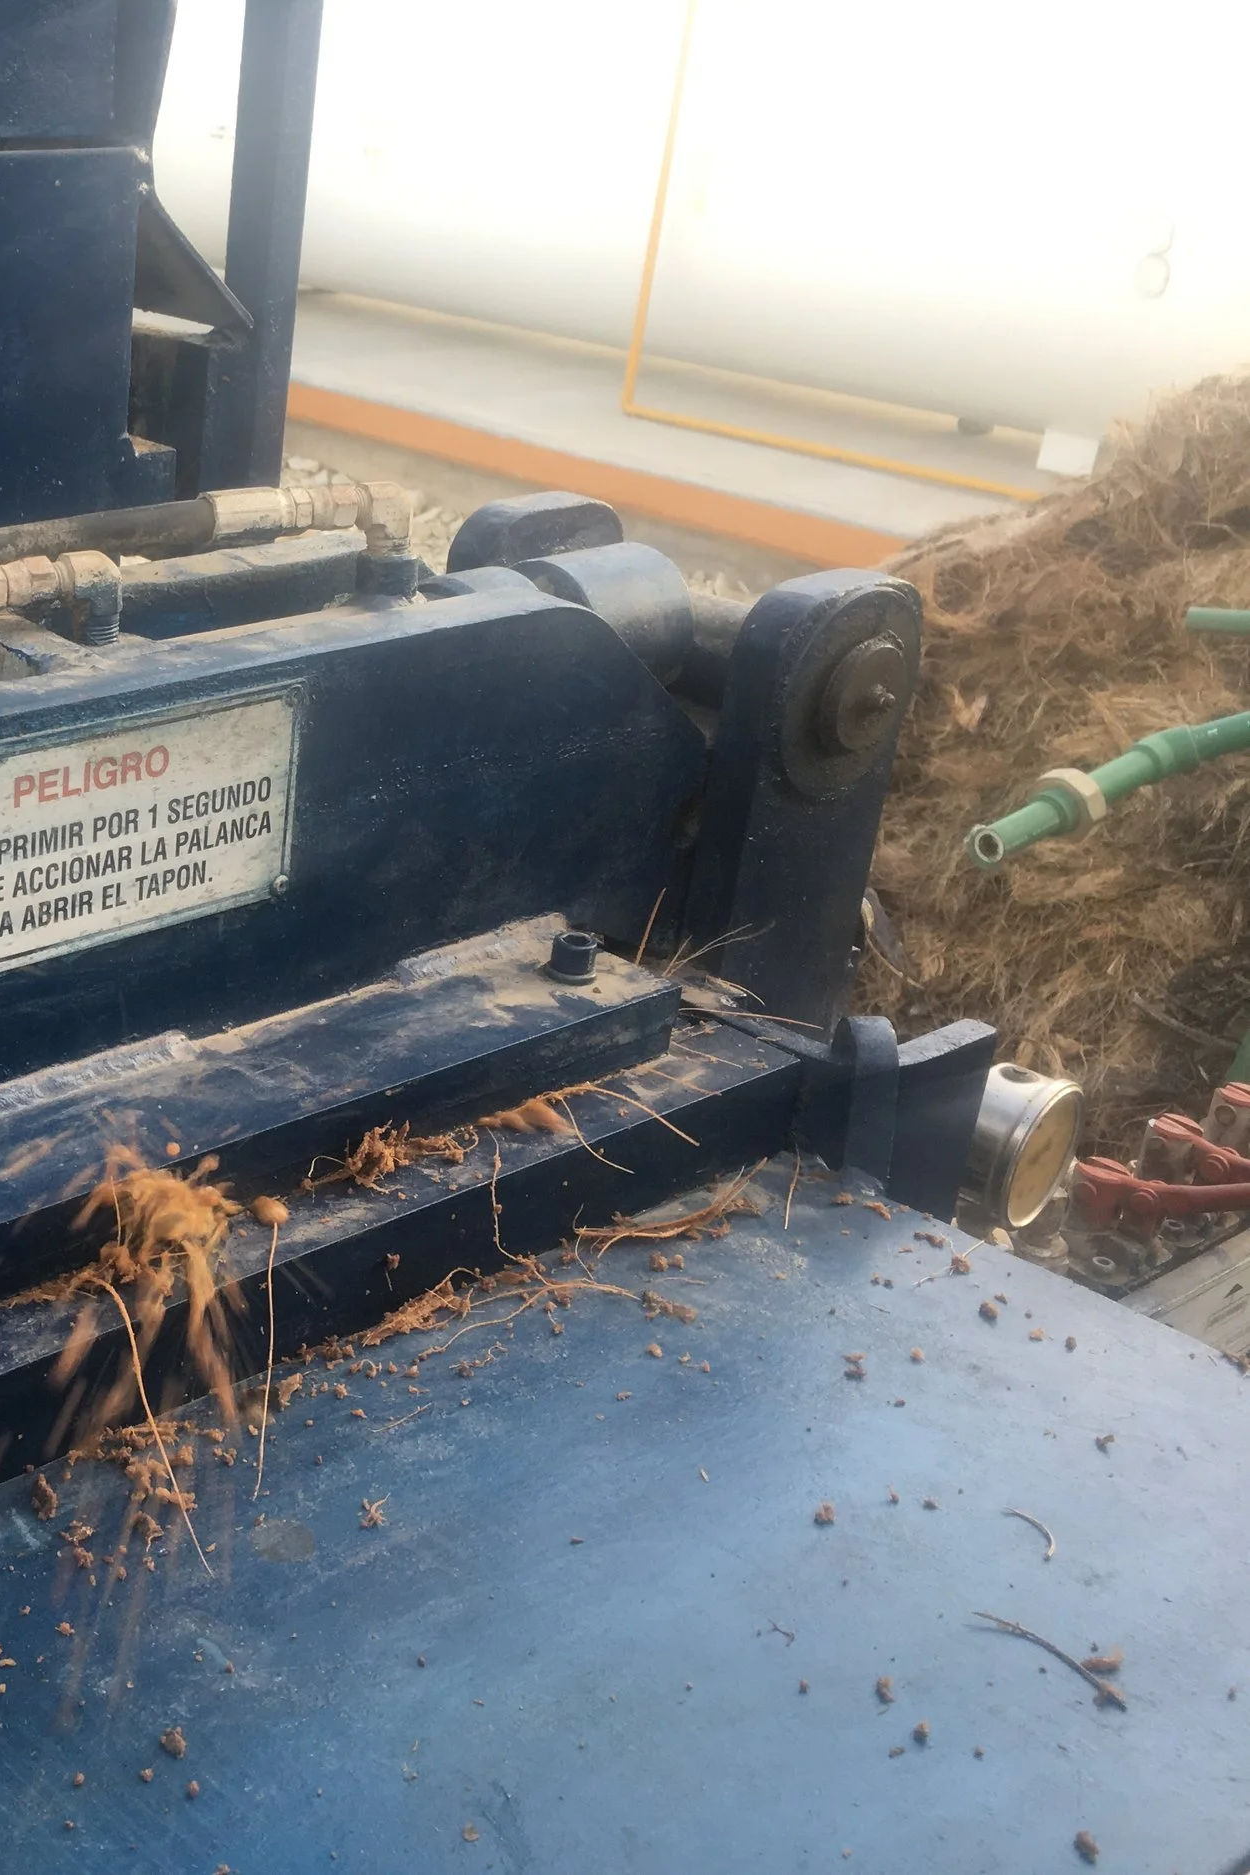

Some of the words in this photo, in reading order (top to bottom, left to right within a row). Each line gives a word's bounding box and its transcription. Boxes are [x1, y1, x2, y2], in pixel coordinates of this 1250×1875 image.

[14, 745, 170, 809] PELIGRO
[93, 808, 139, 843] POR
[148, 803, 158, 829] 1
[167, 776, 272, 825] SEGUNDO
[12, 845, 132, 898] ACCIONAR
[141, 837, 167, 866] LA
[175, 810, 272, 857] PALANCA
[21, 890, 94, 931] ABRIR
[101, 882, 127, 911] EL
[135, 860, 213, 901] TAPON.
